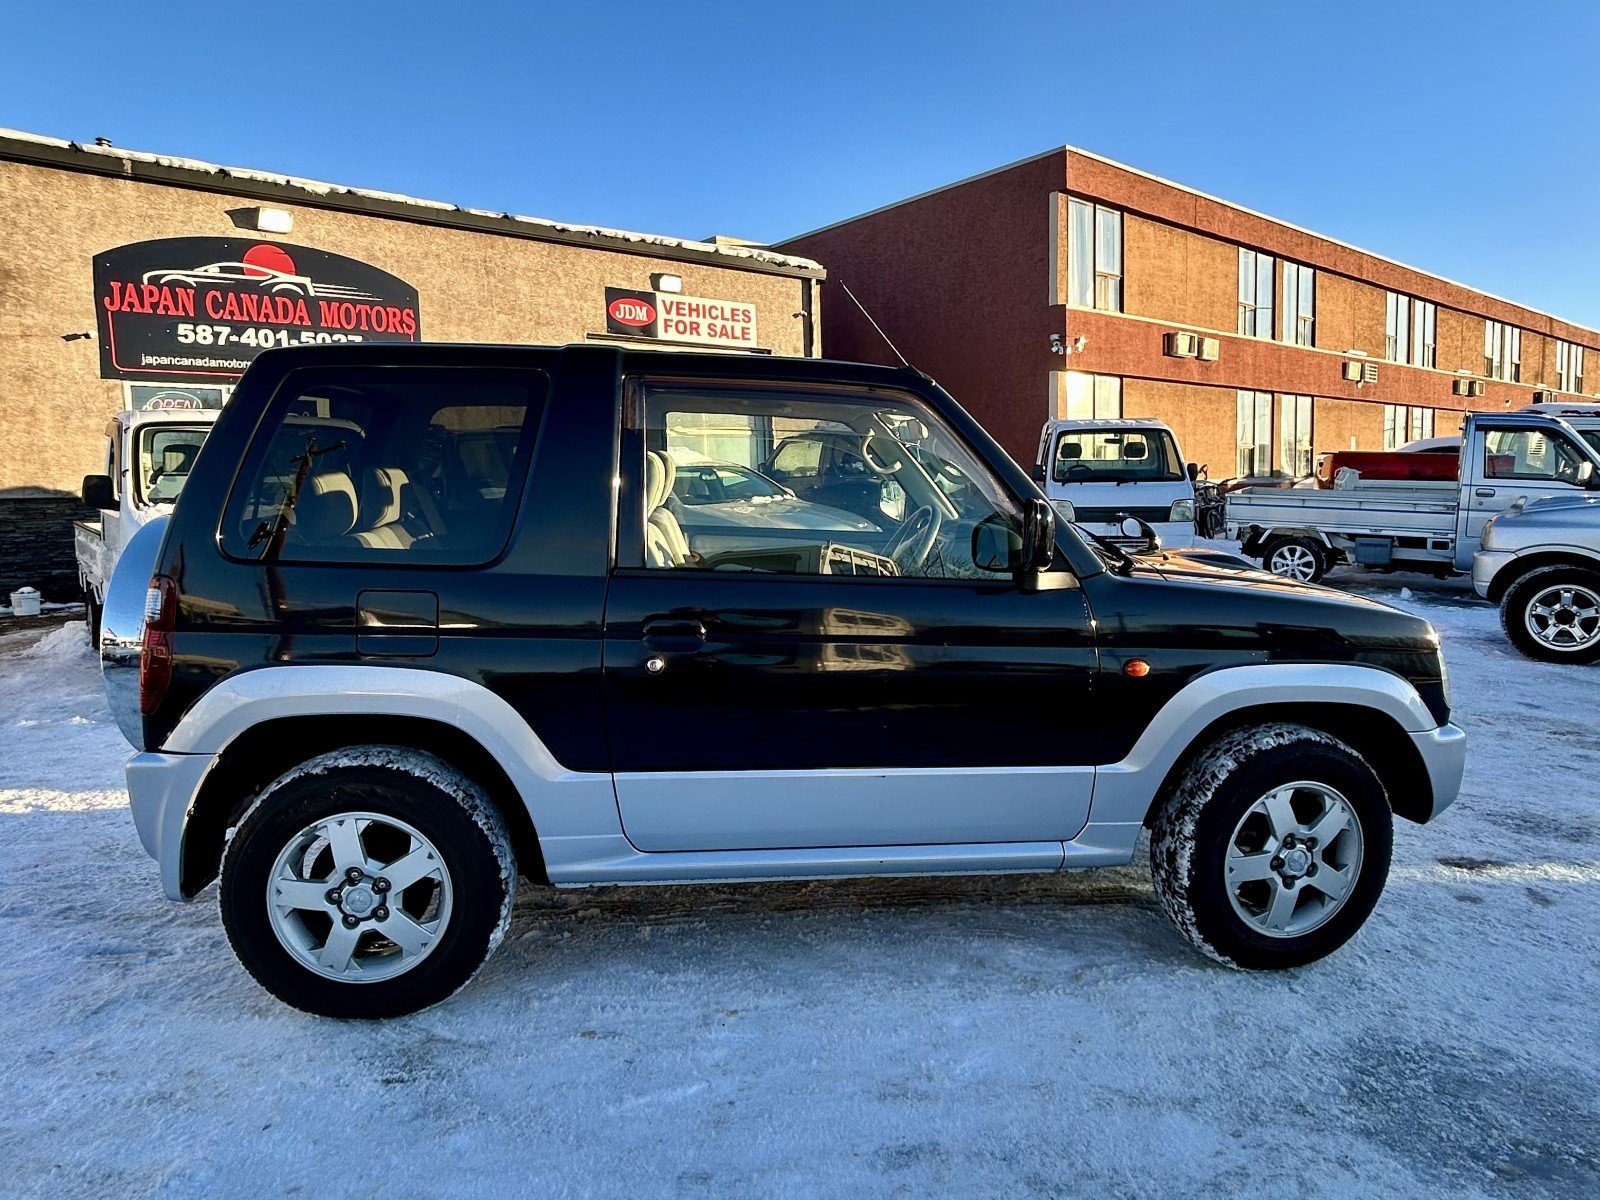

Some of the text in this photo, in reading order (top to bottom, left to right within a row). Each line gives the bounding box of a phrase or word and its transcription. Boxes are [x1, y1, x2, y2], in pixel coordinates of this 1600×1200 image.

[104, 281, 416, 334] JAPAN CANADA MOTORS
[616, 303, 648, 322] JDM
[661, 299, 752, 324] VEHICLES
[663, 318, 751, 341] FOR SALE
